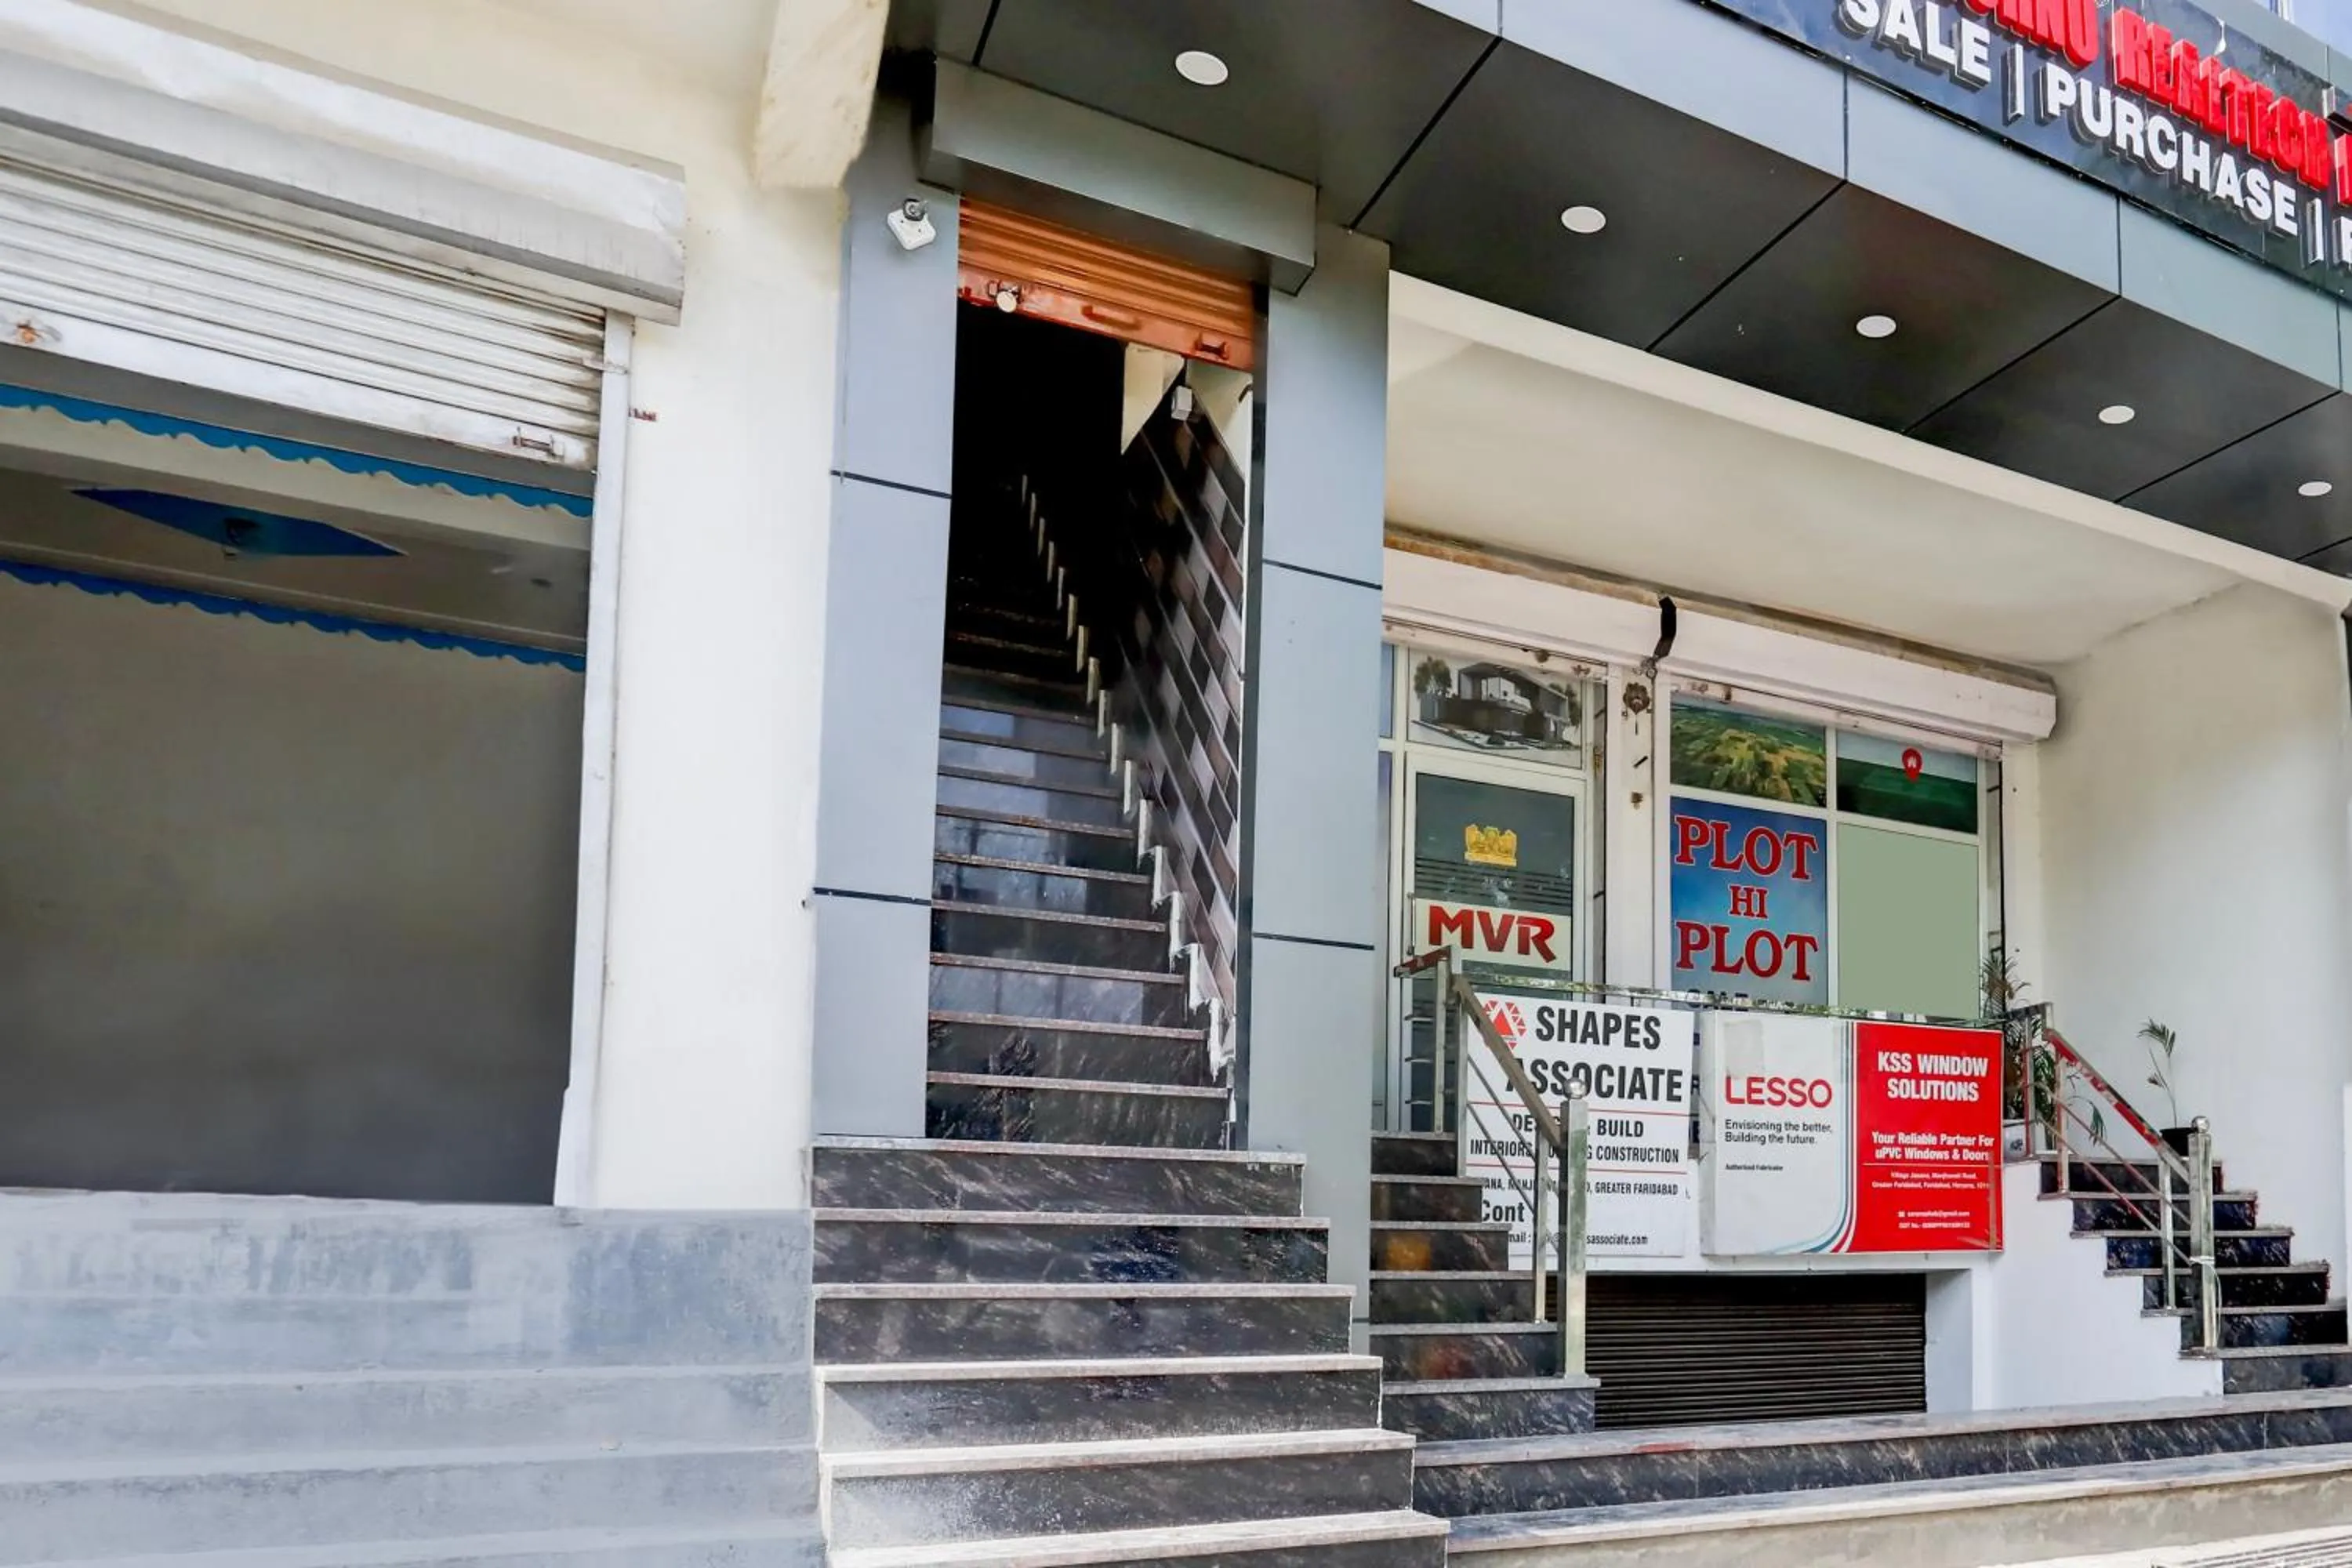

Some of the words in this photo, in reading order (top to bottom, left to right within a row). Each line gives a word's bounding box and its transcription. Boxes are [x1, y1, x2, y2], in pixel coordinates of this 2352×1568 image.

[1844, 0, 1991, 82] SALE
[2042, 62, 2298, 237] PURCHASE
[1674, 815, 1819, 881] PLOT
[1729, 884, 1768, 919] HI
[1428, 905, 1557, 964] MVR
[1675, 920, 1820, 982] PLOT
[1536, 1006, 1661, 1050] SHAPES
[1878, 1051, 1912, 1073] KSS
[1918, 1054, 1988, 1077] WINDOW
[1505, 1058, 1683, 1102] SSOCIATE
[1726, 1075, 1832, 1108] LESSO
[1887, 1078, 1979, 1102] SOLUTIONS
[1597, 1119, 1644, 1138] BUILD
[1725, 1119, 1782, 1133] Envisioning
[1784, 1121, 1800, 1131] the
[1725, 1131, 1766, 1145] Building
[1769, 1134, 1784, 1144] the
[1871, 1131, 1896, 1144] Your
[1898, 1131, 1937, 1145] Reliable
[1940, 1134, 1976, 1146] Partner
[1978, 1135, 1994, 1146] For
[1595, 1145, 1679, 1163] CONSTRUCTION
[1875, 1147, 1902, 1160] uPVC
[1904, 1148, 1949, 1160] Windows
[1951, 1149, 1960, 1160] &
[1595, 1182, 1631, 1194] GREATER
[1633, 1183, 1679, 1196] FARIDABAD
